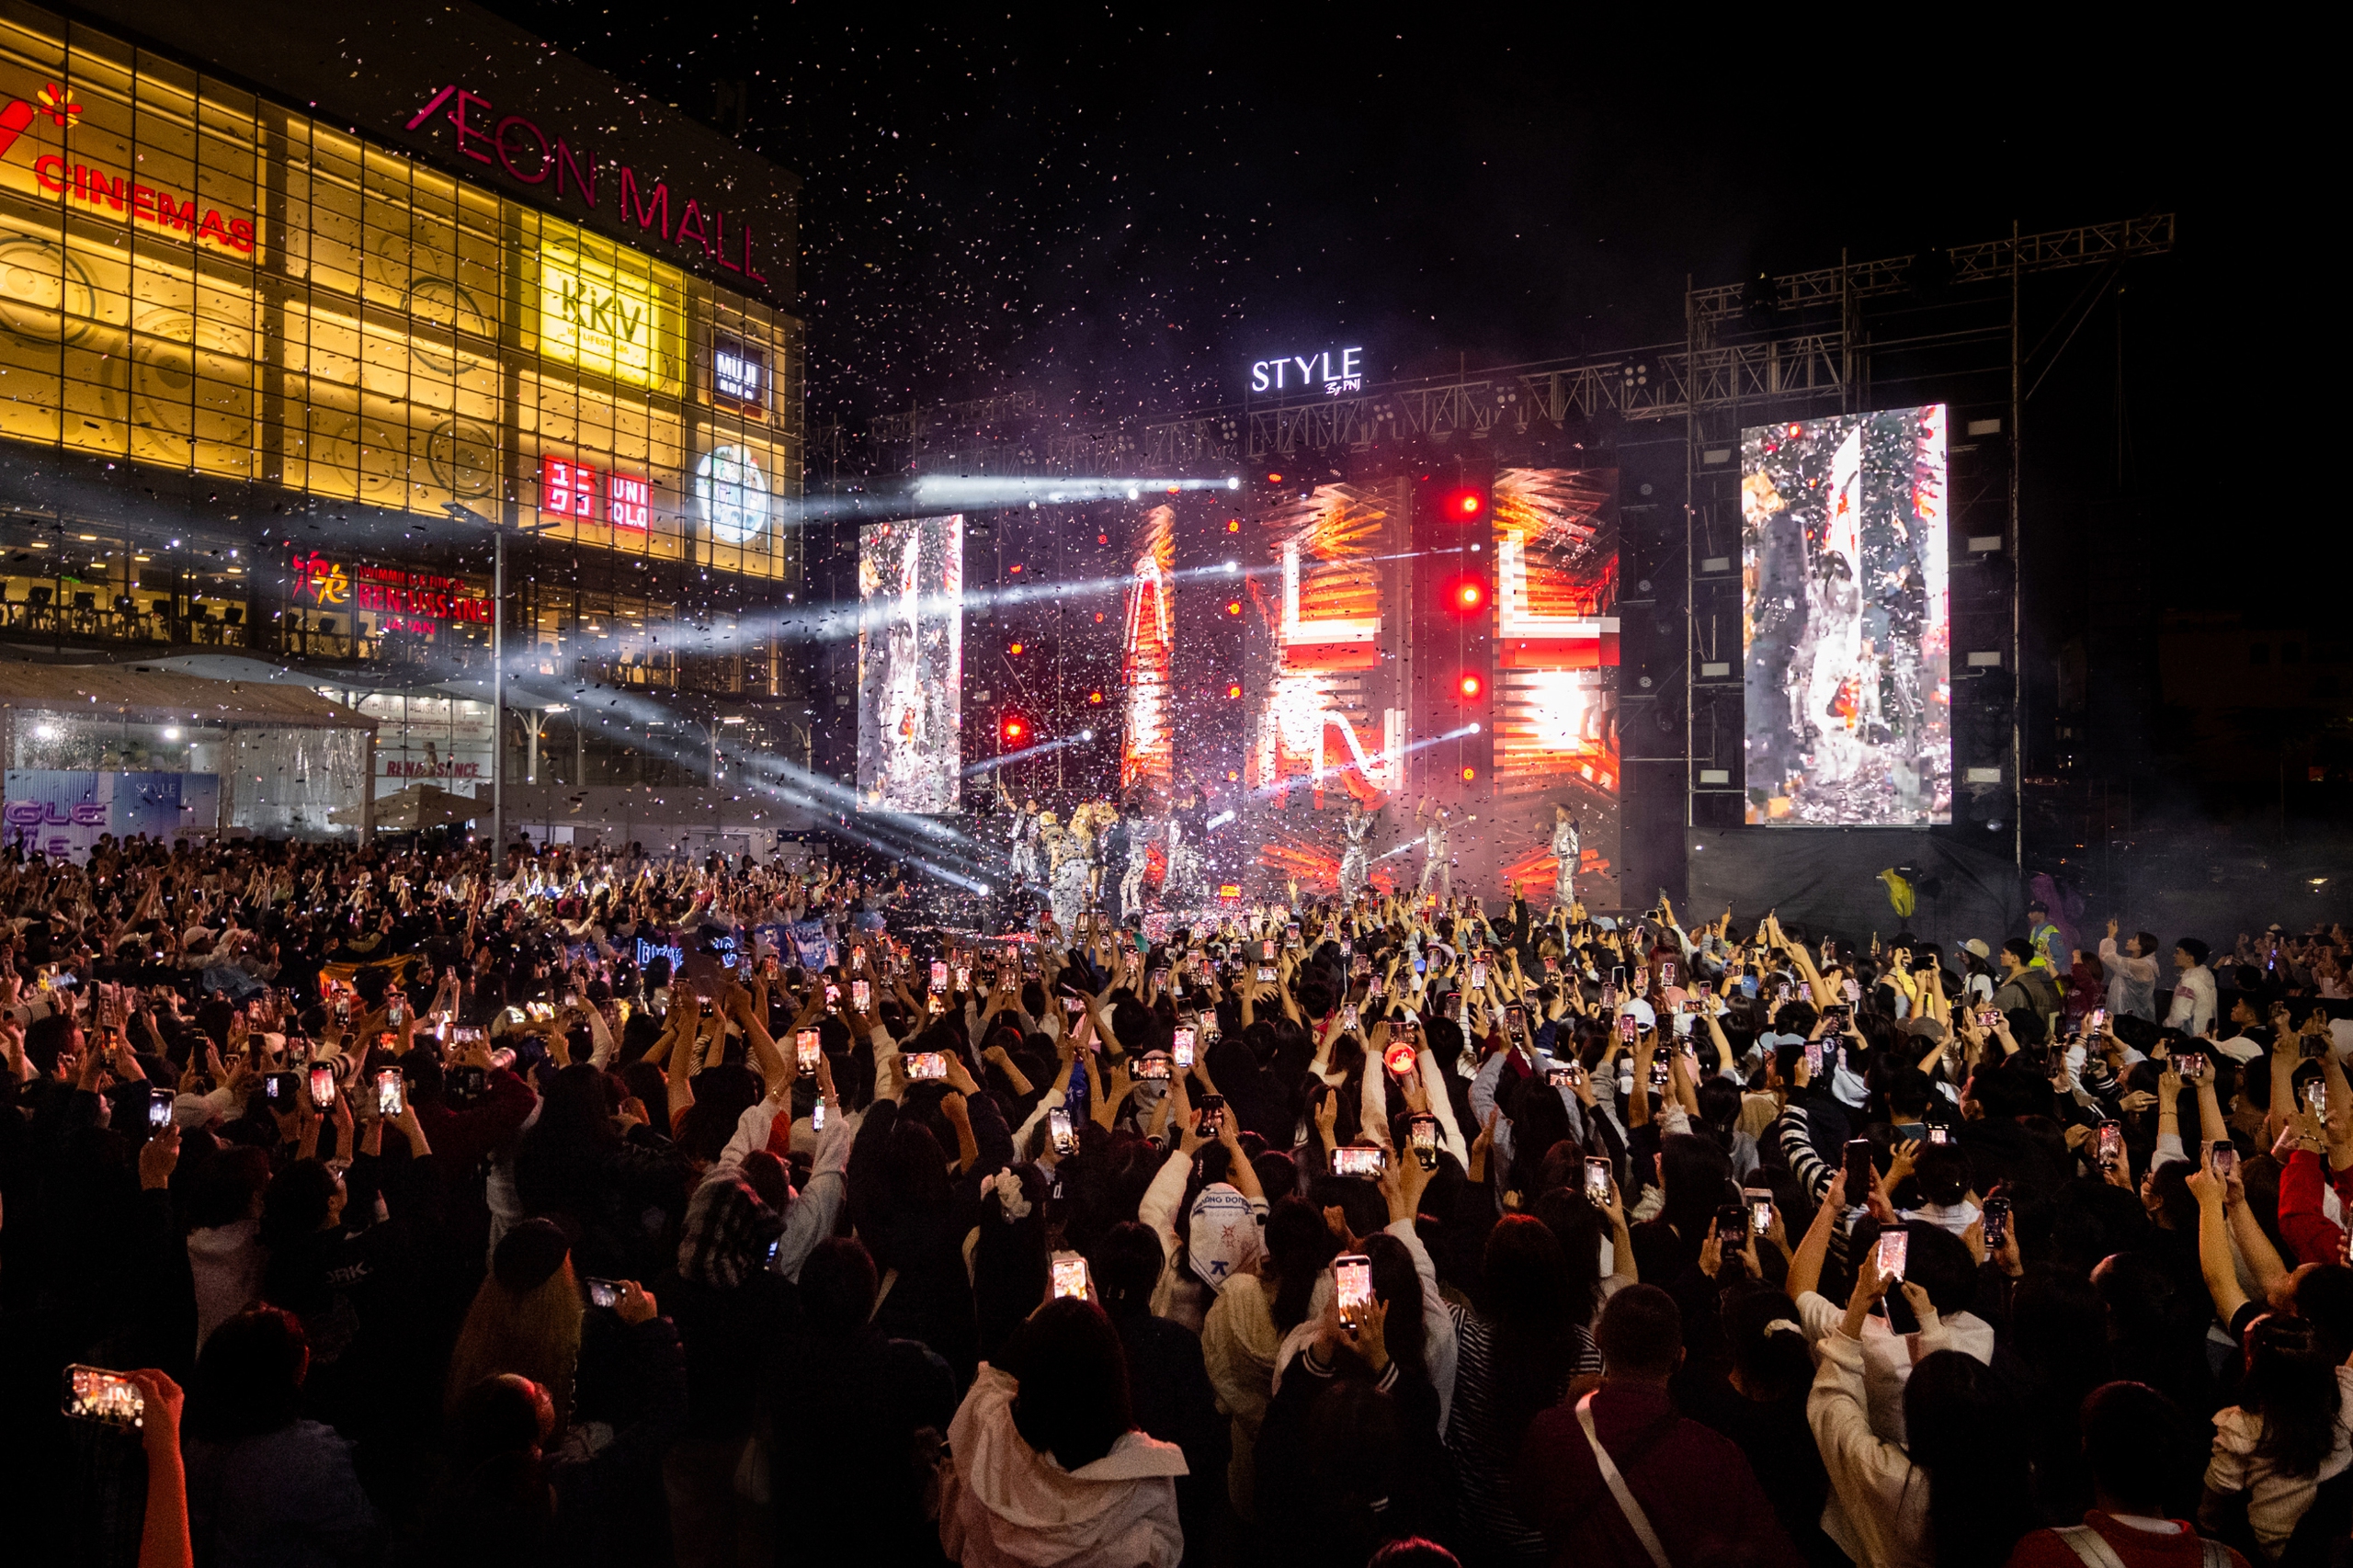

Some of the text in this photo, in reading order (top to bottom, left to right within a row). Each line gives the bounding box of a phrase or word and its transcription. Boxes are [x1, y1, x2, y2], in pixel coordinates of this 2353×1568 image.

[35, 154, 255, 253] CINEMAS
[620, 166, 767, 284] MALL
[717, 353, 756, 388] MUJI
[1251, 347, 1363, 392] STYLE
[1324, 378, 1361, 396] By PNJ
[614, 478, 648, 501] UNI
[613, 505, 648, 528] QLO
[418, 576, 426, 587] &
[429, 576, 465, 592] FITNSS
[396, 702, 436, 715] PRPOSE
[386, 760, 480, 778] RENASANCE
[135, 782, 176, 794] STYLE
